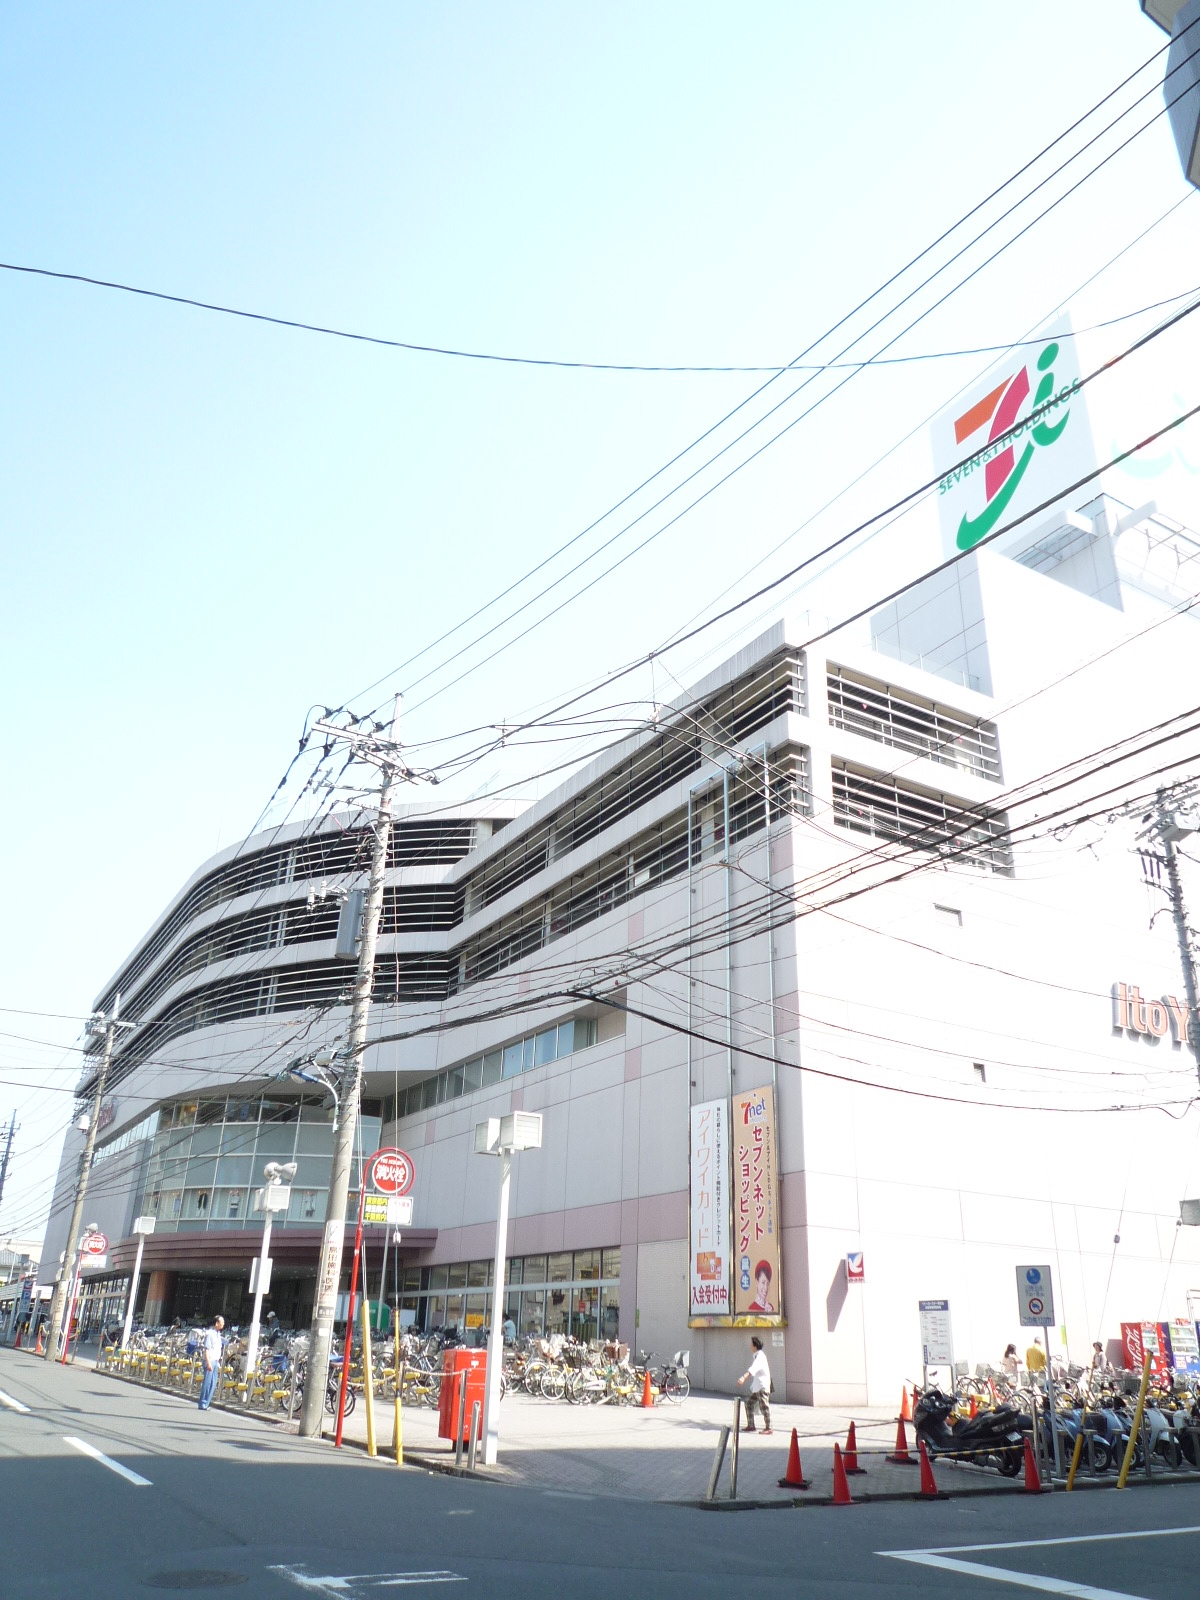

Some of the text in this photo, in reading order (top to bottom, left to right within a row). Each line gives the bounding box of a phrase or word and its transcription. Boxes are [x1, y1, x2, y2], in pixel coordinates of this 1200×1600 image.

[1002, 377, 1081, 443] HOLDINGS
[741, 1098, 766, 1124] 7net
[376, 1164, 406, 1182] 消火栓
[697, 1110, 711, 1248] アイワイカード
[739, 1146, 751, 1253] ショッピング
[752, 1126, 765, 1241] セブンネット
[692, 1285, 727, 1305] 入会受付中
